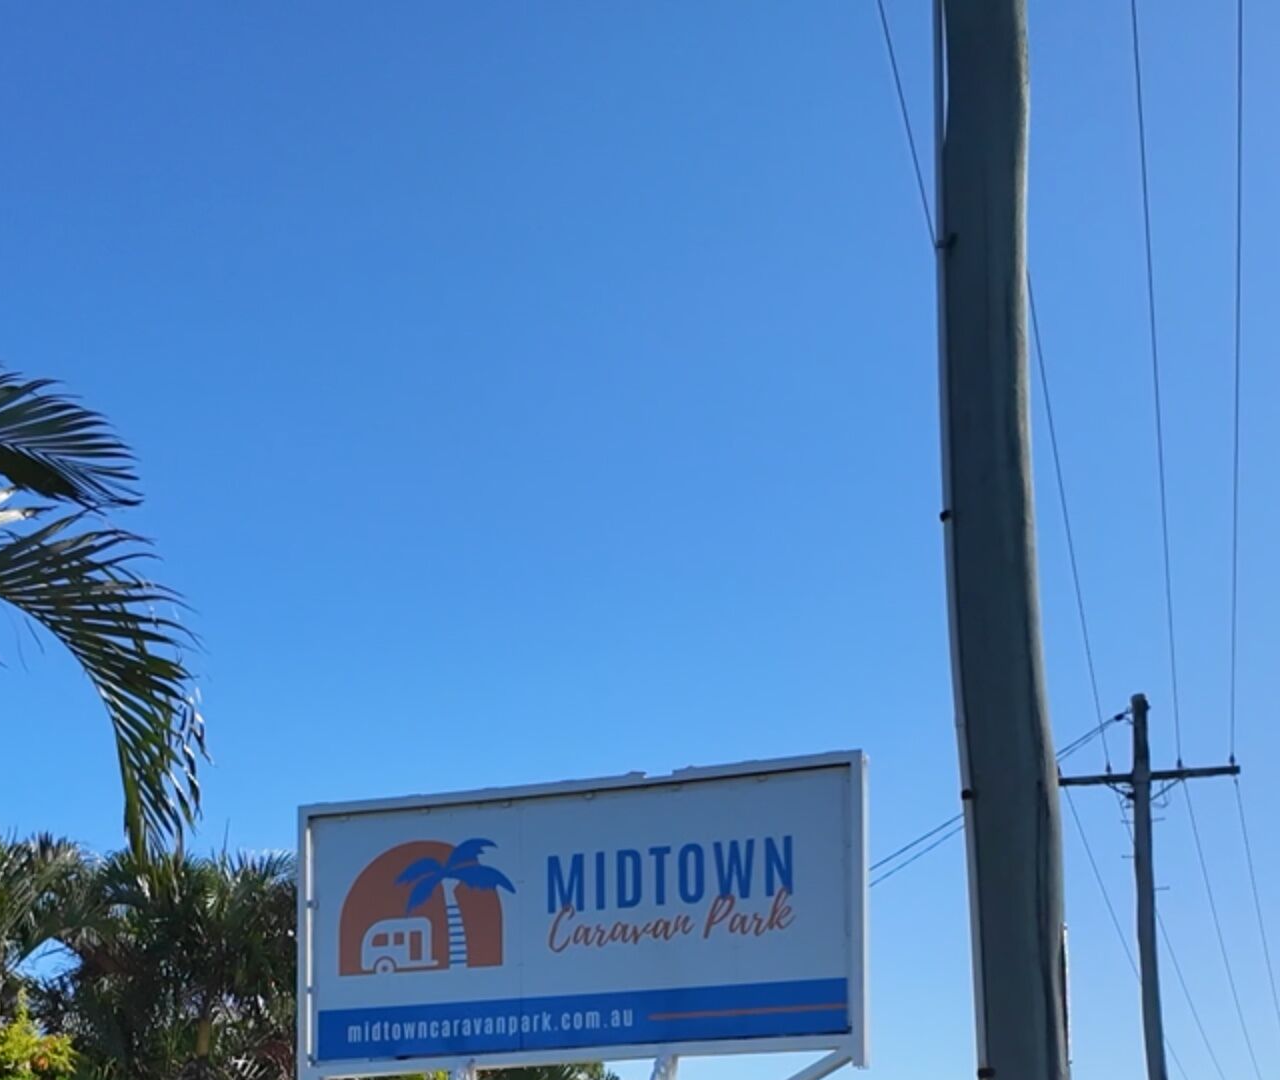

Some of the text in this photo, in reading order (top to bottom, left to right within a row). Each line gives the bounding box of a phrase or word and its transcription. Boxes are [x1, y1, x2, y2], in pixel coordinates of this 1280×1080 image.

[547, 835, 794, 914] MIDTOWN
[548, 886, 795, 954] Caravan Park
[346, 1008, 634, 1044] midtowncaravanpark.com.au
